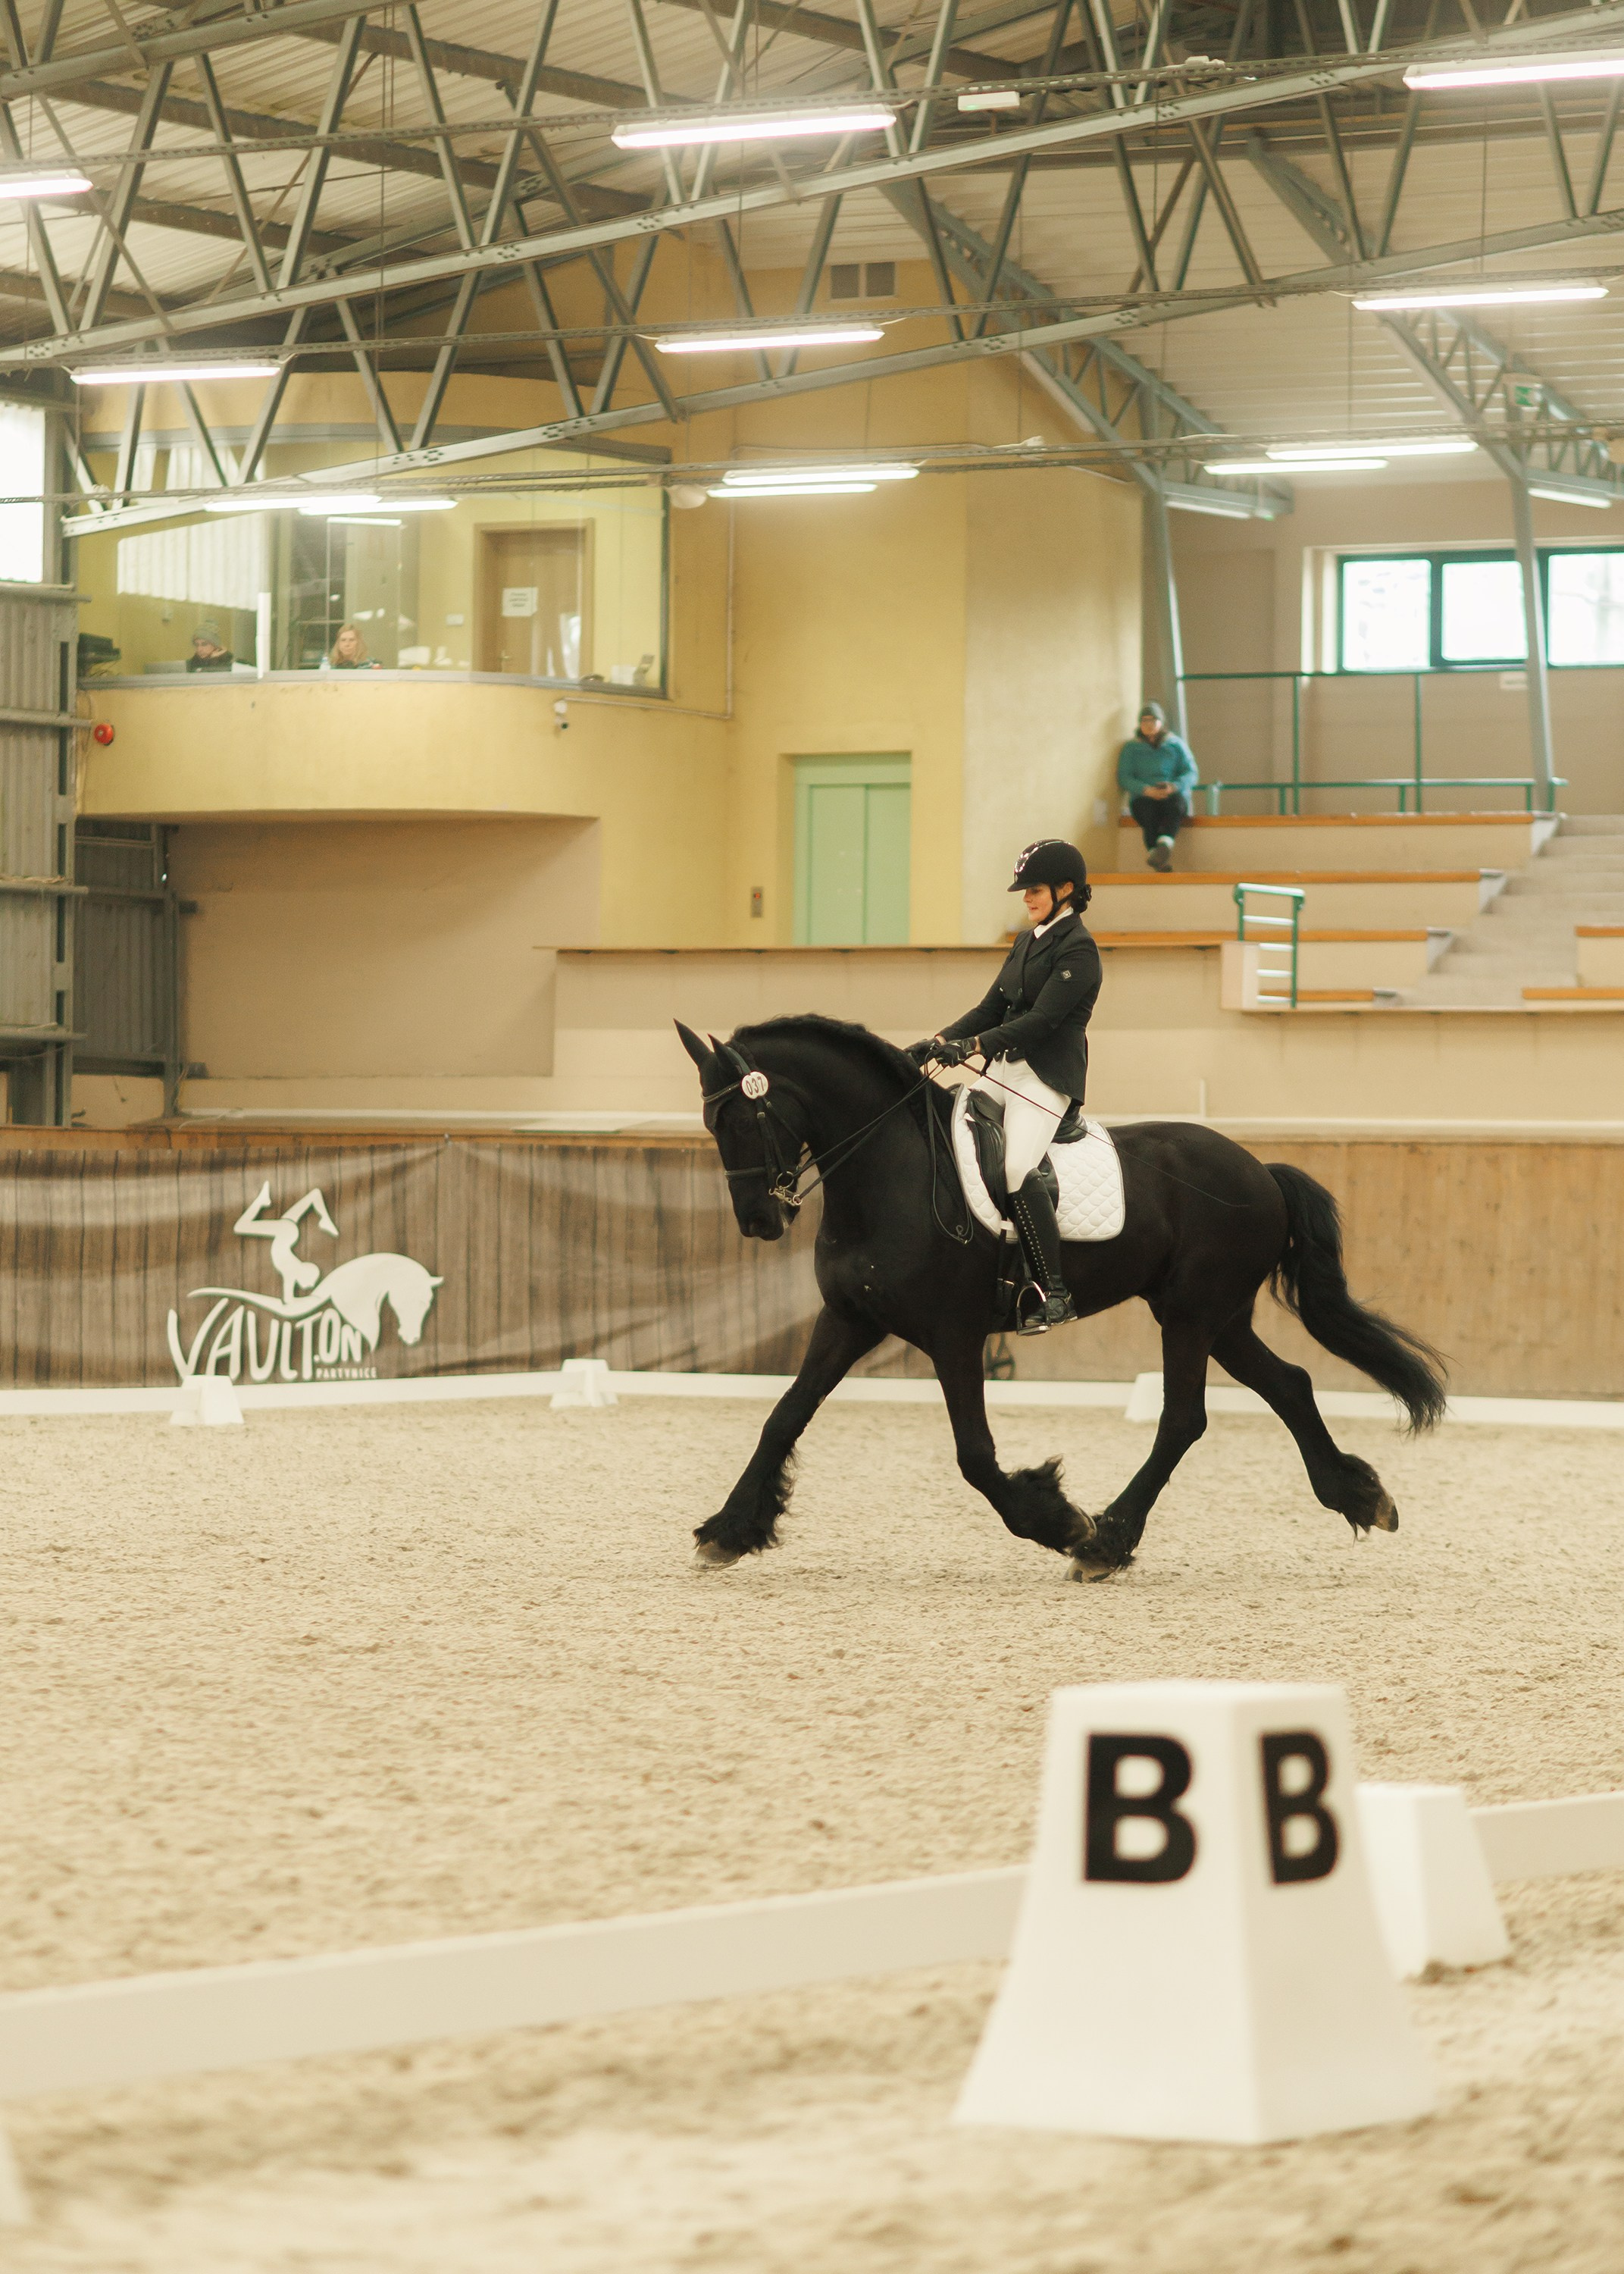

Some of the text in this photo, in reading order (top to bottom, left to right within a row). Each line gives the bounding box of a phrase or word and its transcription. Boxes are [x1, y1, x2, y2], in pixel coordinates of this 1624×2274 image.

[746, 1076, 764, 1095] 037
[1084, 1731, 1196, 1884] B
[1259, 1731, 1340, 1884] B
